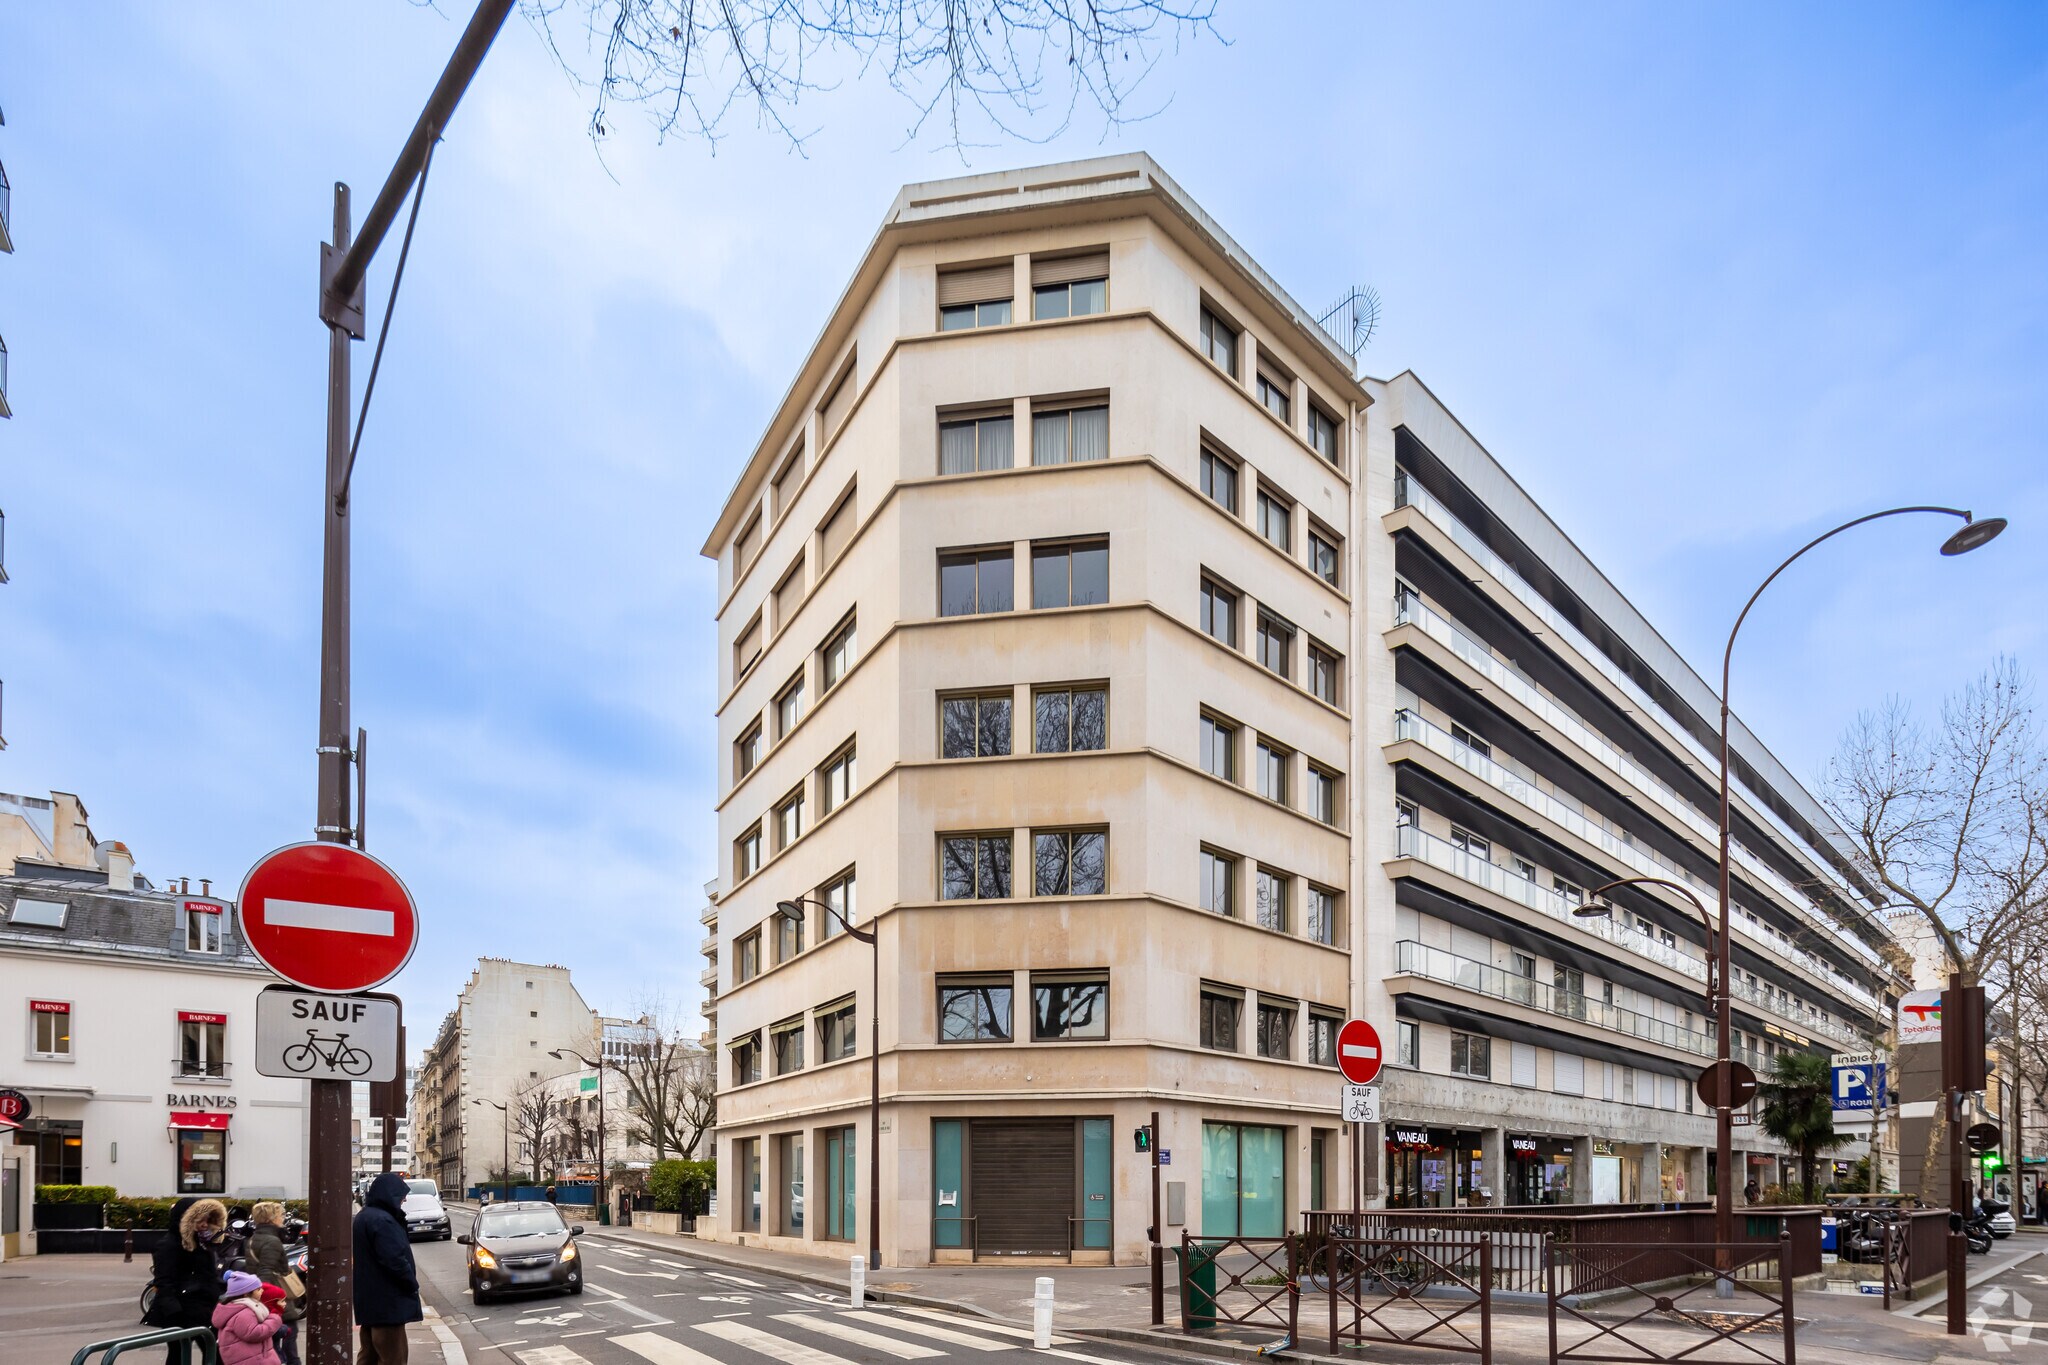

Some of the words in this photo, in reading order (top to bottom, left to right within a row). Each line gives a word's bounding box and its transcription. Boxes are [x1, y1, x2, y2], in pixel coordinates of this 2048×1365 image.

[190, 904, 217, 912] BARNES
[35, 1003, 66, 1011] BARNES
[292, 999, 366, 1023] SAUF
[1838, 1069, 1866, 1098] P
[1351, 1087, 1371, 1097] SAUF
[167, 1093, 237, 1108] BARNES
[1396, 1131, 1428, 1144] VANEAU
[1512, 1139, 1536, 1150] VANEAU
